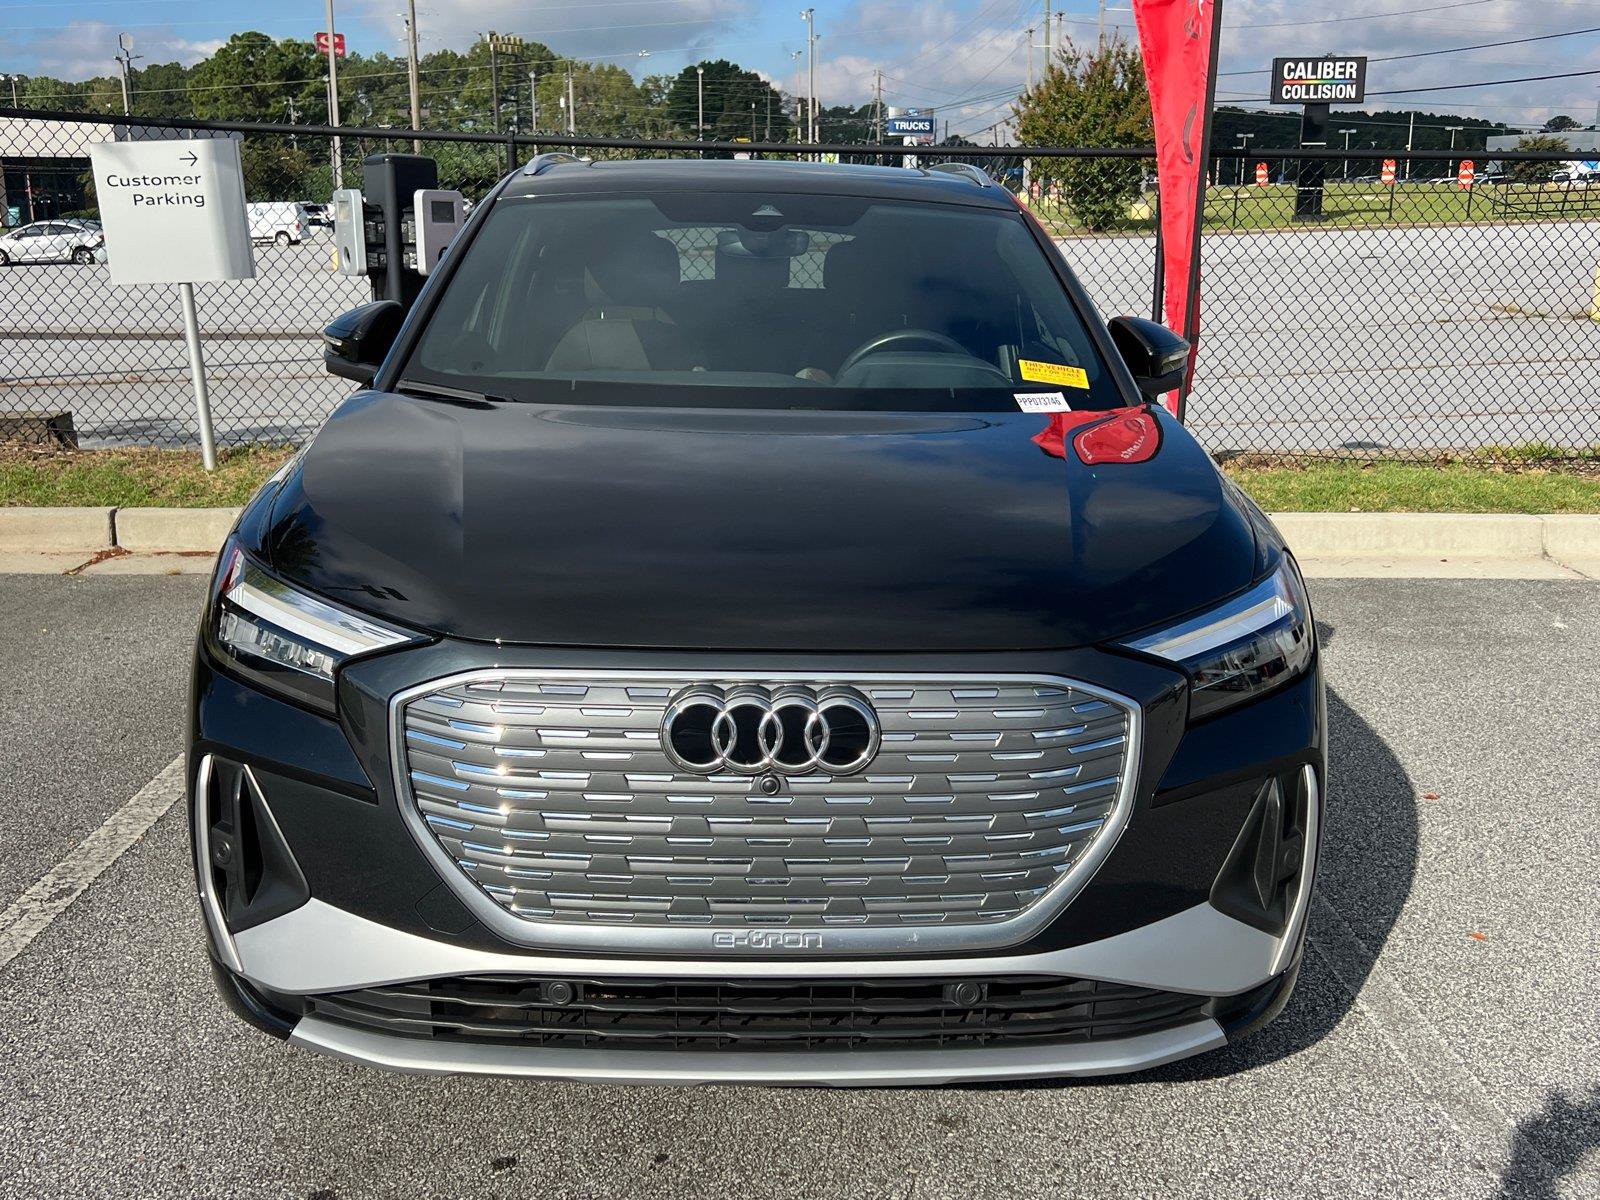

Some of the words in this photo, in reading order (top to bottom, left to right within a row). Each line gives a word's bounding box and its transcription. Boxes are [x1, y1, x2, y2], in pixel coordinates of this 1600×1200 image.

[1283, 61, 1357, 80] CALIBER
[1281, 84, 1356, 99] COLLISION
[894, 121, 930, 131] TRUCKS
[107, 175, 201, 187] Customer
[133, 193, 204, 207] Parking
[1024, 361, 1043, 369] THIS
[1045, 364, 1082, 374] VEHICLE
[712, 930, 823, 949] e-tron
